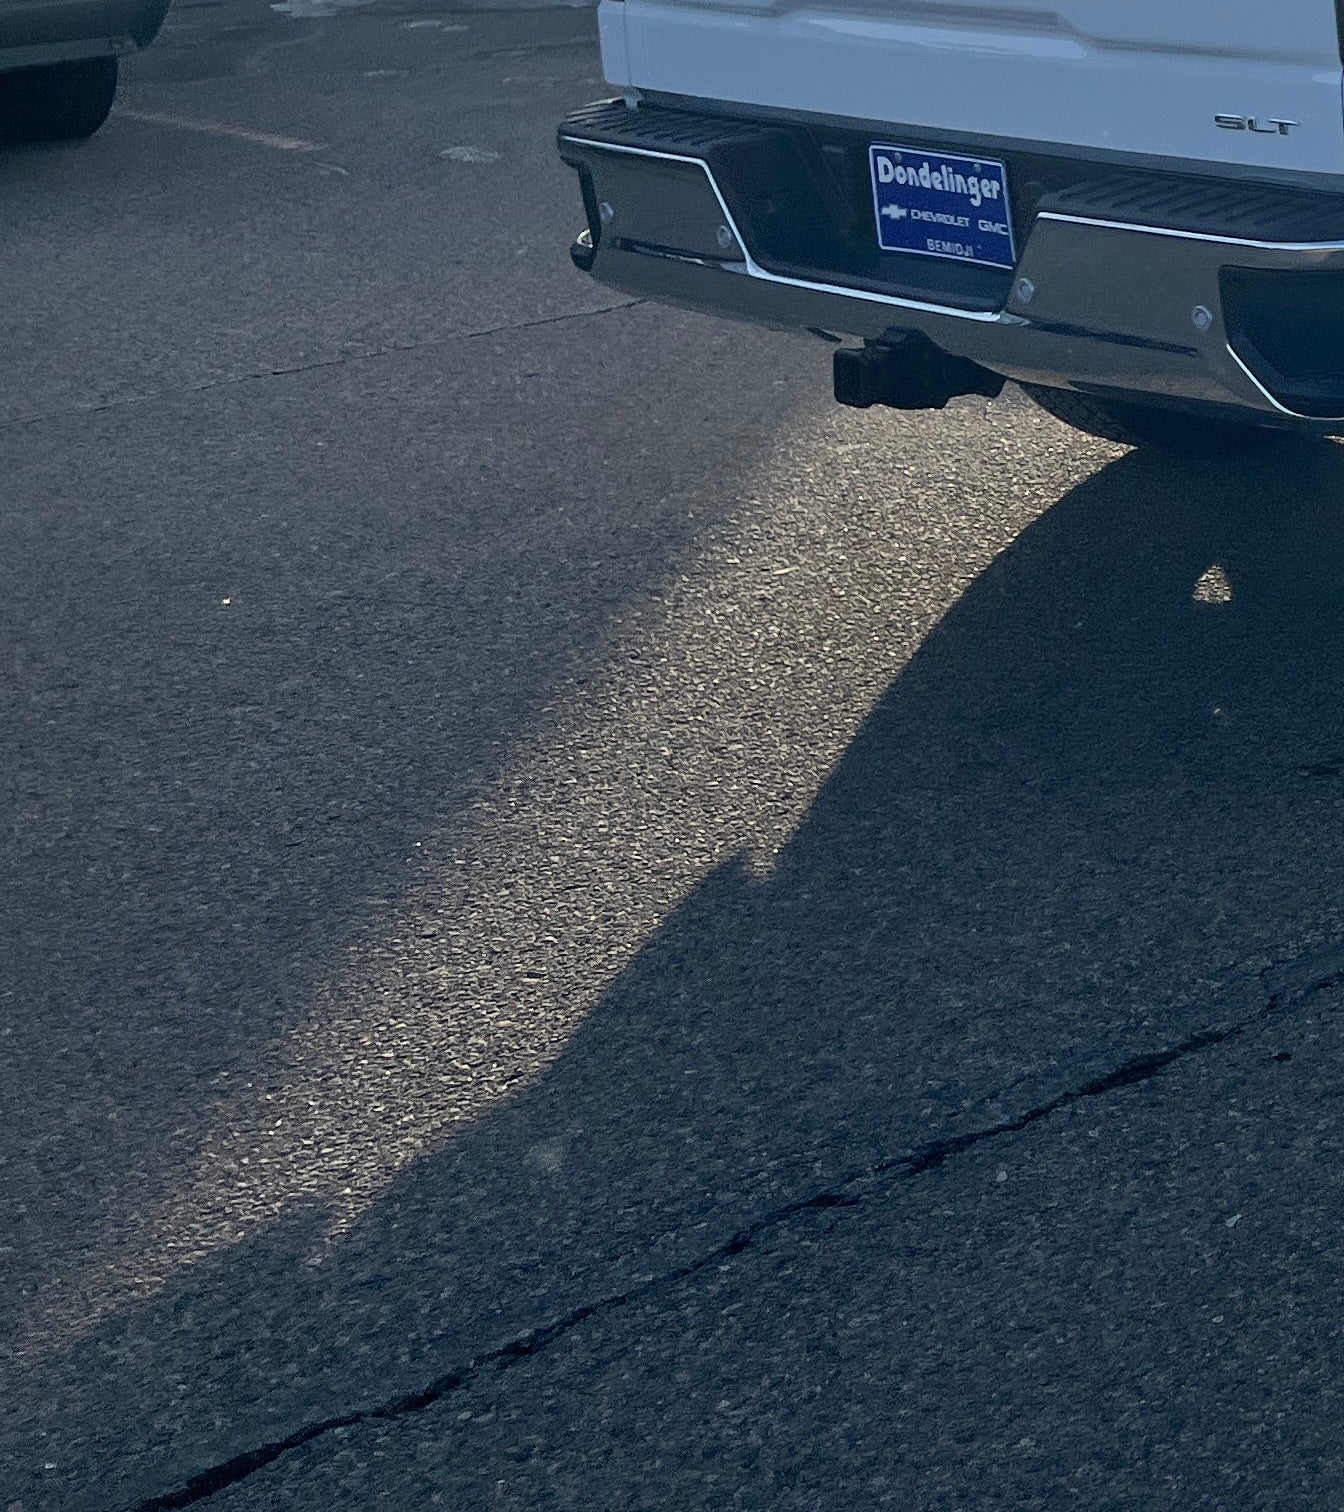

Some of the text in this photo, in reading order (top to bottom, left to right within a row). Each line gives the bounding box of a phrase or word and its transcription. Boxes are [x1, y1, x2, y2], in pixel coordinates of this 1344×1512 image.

[1214, 112, 1300, 136] SLT
[876, 155, 1000, 207] Dondelinger
[911, 209, 1008, 235] CHEVROLET GMC
